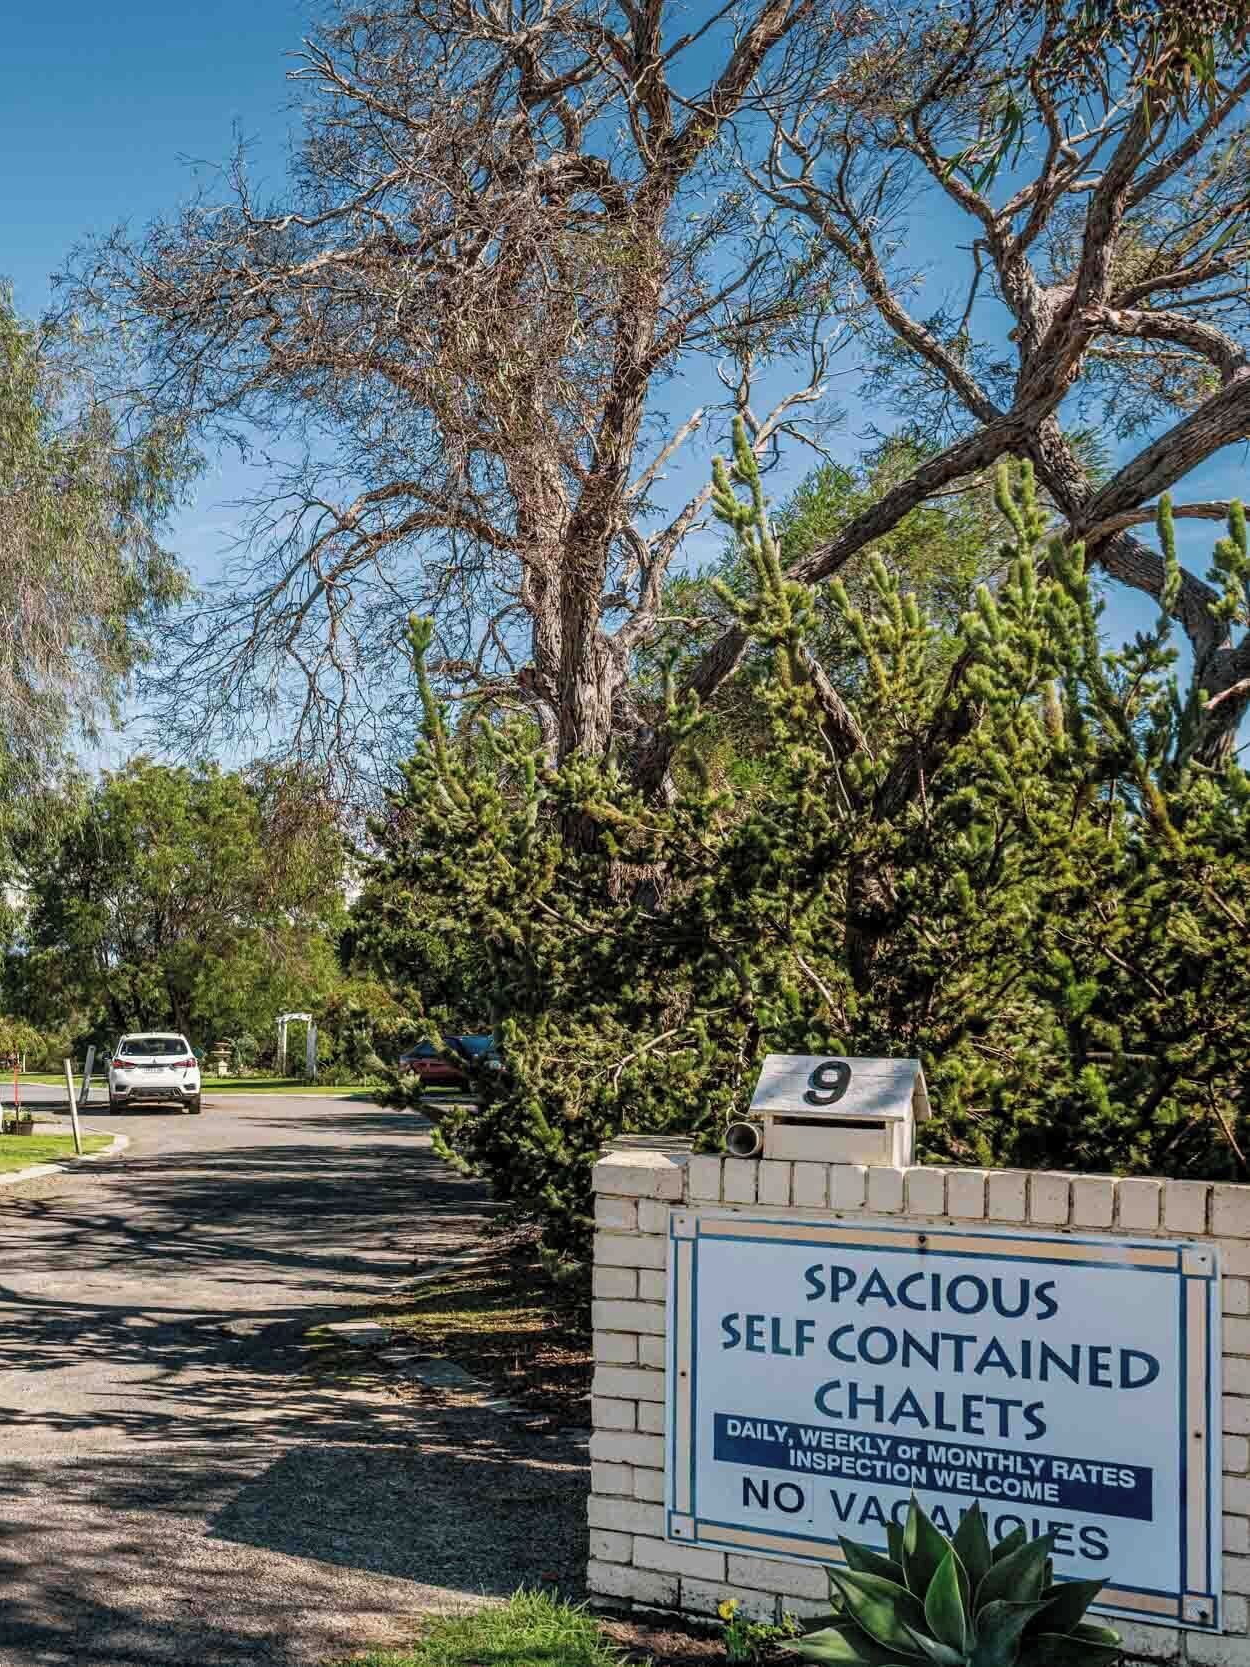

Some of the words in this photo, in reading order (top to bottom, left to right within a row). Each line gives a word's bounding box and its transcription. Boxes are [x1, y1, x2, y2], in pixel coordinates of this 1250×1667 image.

[803, 1061, 852, 1106] 9
[804, 1263, 1059, 1320] SPACIOUS
[721, 1313, 816, 1357] SELF
[828, 1323, 1161, 1389] CONTAINED
[814, 1380, 1047, 1441] CHALETS
[726, 1420, 794, 1446] DAILY,
[800, 1429, 891, 1458] WEEKLY
[898, 1444, 920, 1461] or
[928, 1447, 1045, 1478] MONTHLY
[1052, 1461, 1136, 1489] RATES
[789, 1450, 927, 1485] INSPECTION
[934, 1469, 1060, 1502] WELCOME
[742, 1477, 805, 1514] NO
